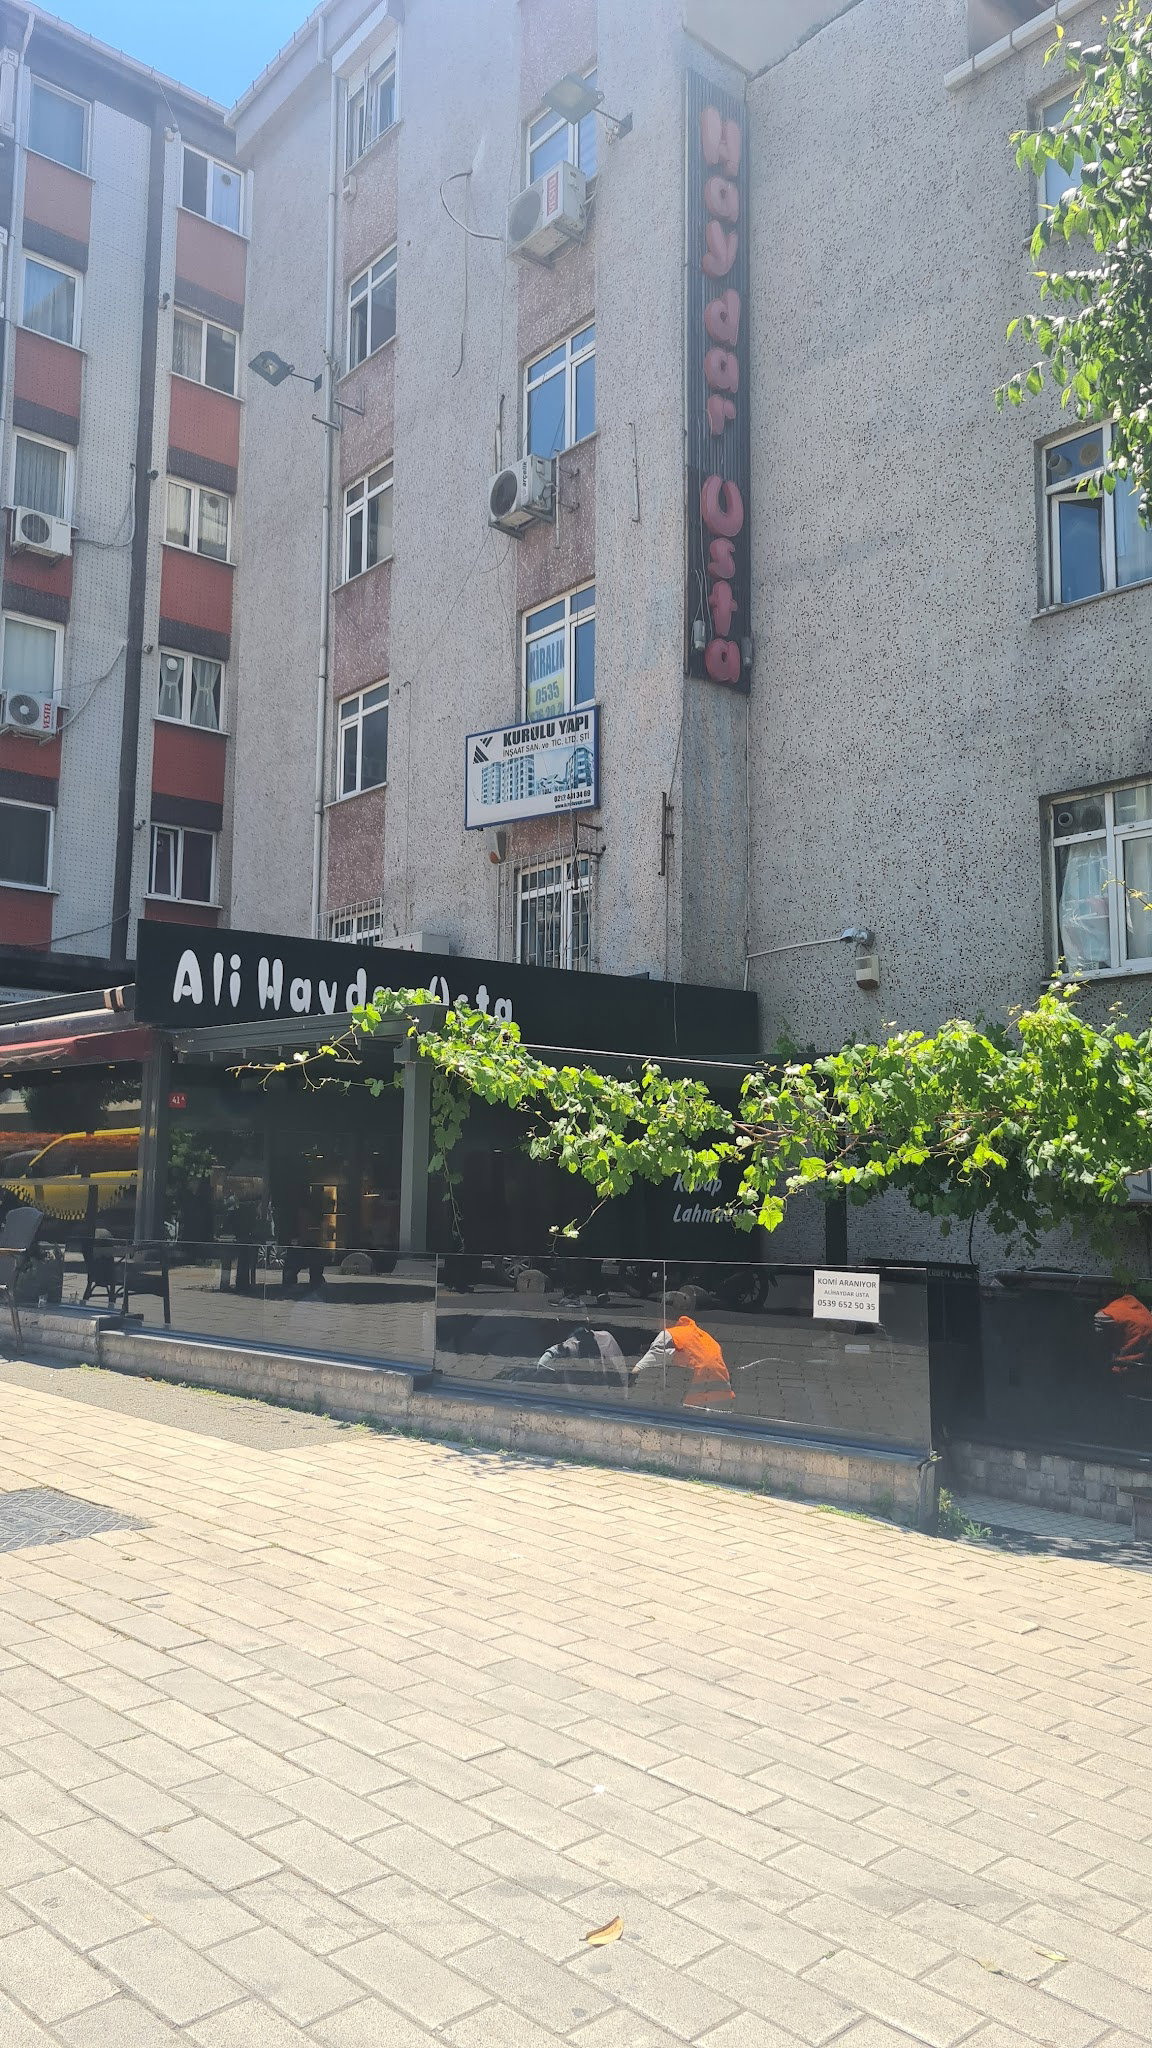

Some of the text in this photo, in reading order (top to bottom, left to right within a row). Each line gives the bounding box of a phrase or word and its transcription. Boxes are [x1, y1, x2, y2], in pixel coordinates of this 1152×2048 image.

[701, 105, 744, 684] Haydar Usta
[535, 681, 560, 706] 0535
[43, 703, 52, 729] VESTEL
[503, 714, 589, 748] KURULU YAPI
[502, 746, 524, 758] İNŞAAT
[525, 742, 540, 753] SAN.
[580, 731, 590, 743] ŞTİ
[173, 949, 242, 1008] Ali
[257, 957, 395, 1014] Hayd
[673, 1173, 723, 1197] Kbap
[673, 1203, 750, 1223] Lahmac
[817, 1278, 877, 1288] KOMİ ARANIYOR
[817, 1299, 876, 1311] 0539 652 50 35
